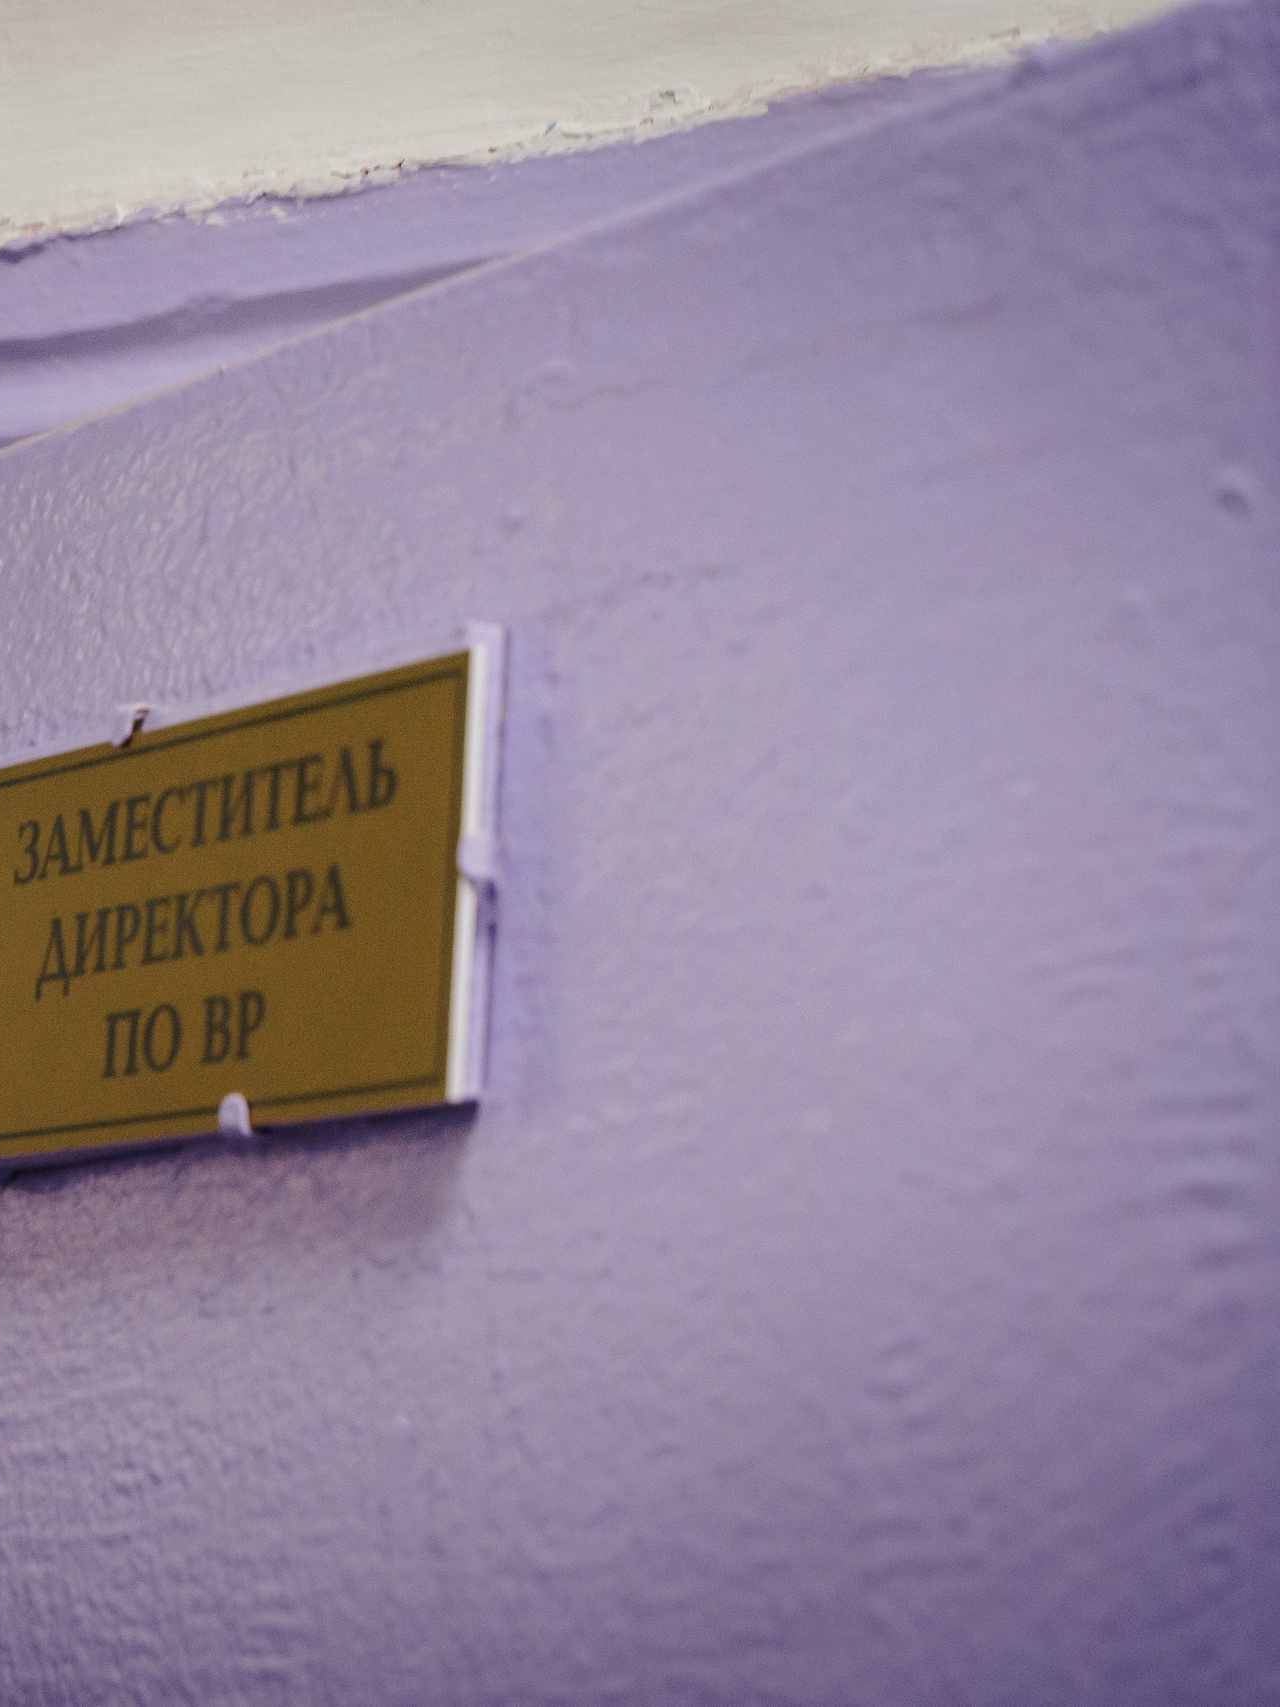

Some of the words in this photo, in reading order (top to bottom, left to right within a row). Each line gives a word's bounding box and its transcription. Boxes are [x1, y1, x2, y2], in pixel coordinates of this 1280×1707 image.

[14, 738, 397, 885] ЗАМЕСТИТЕЛЬ
[35, 864, 353, 1000] ДИРЕКТОРА
[101, 1002, 182, 1079] ПО
[201, 990, 267, 1065] ВР
